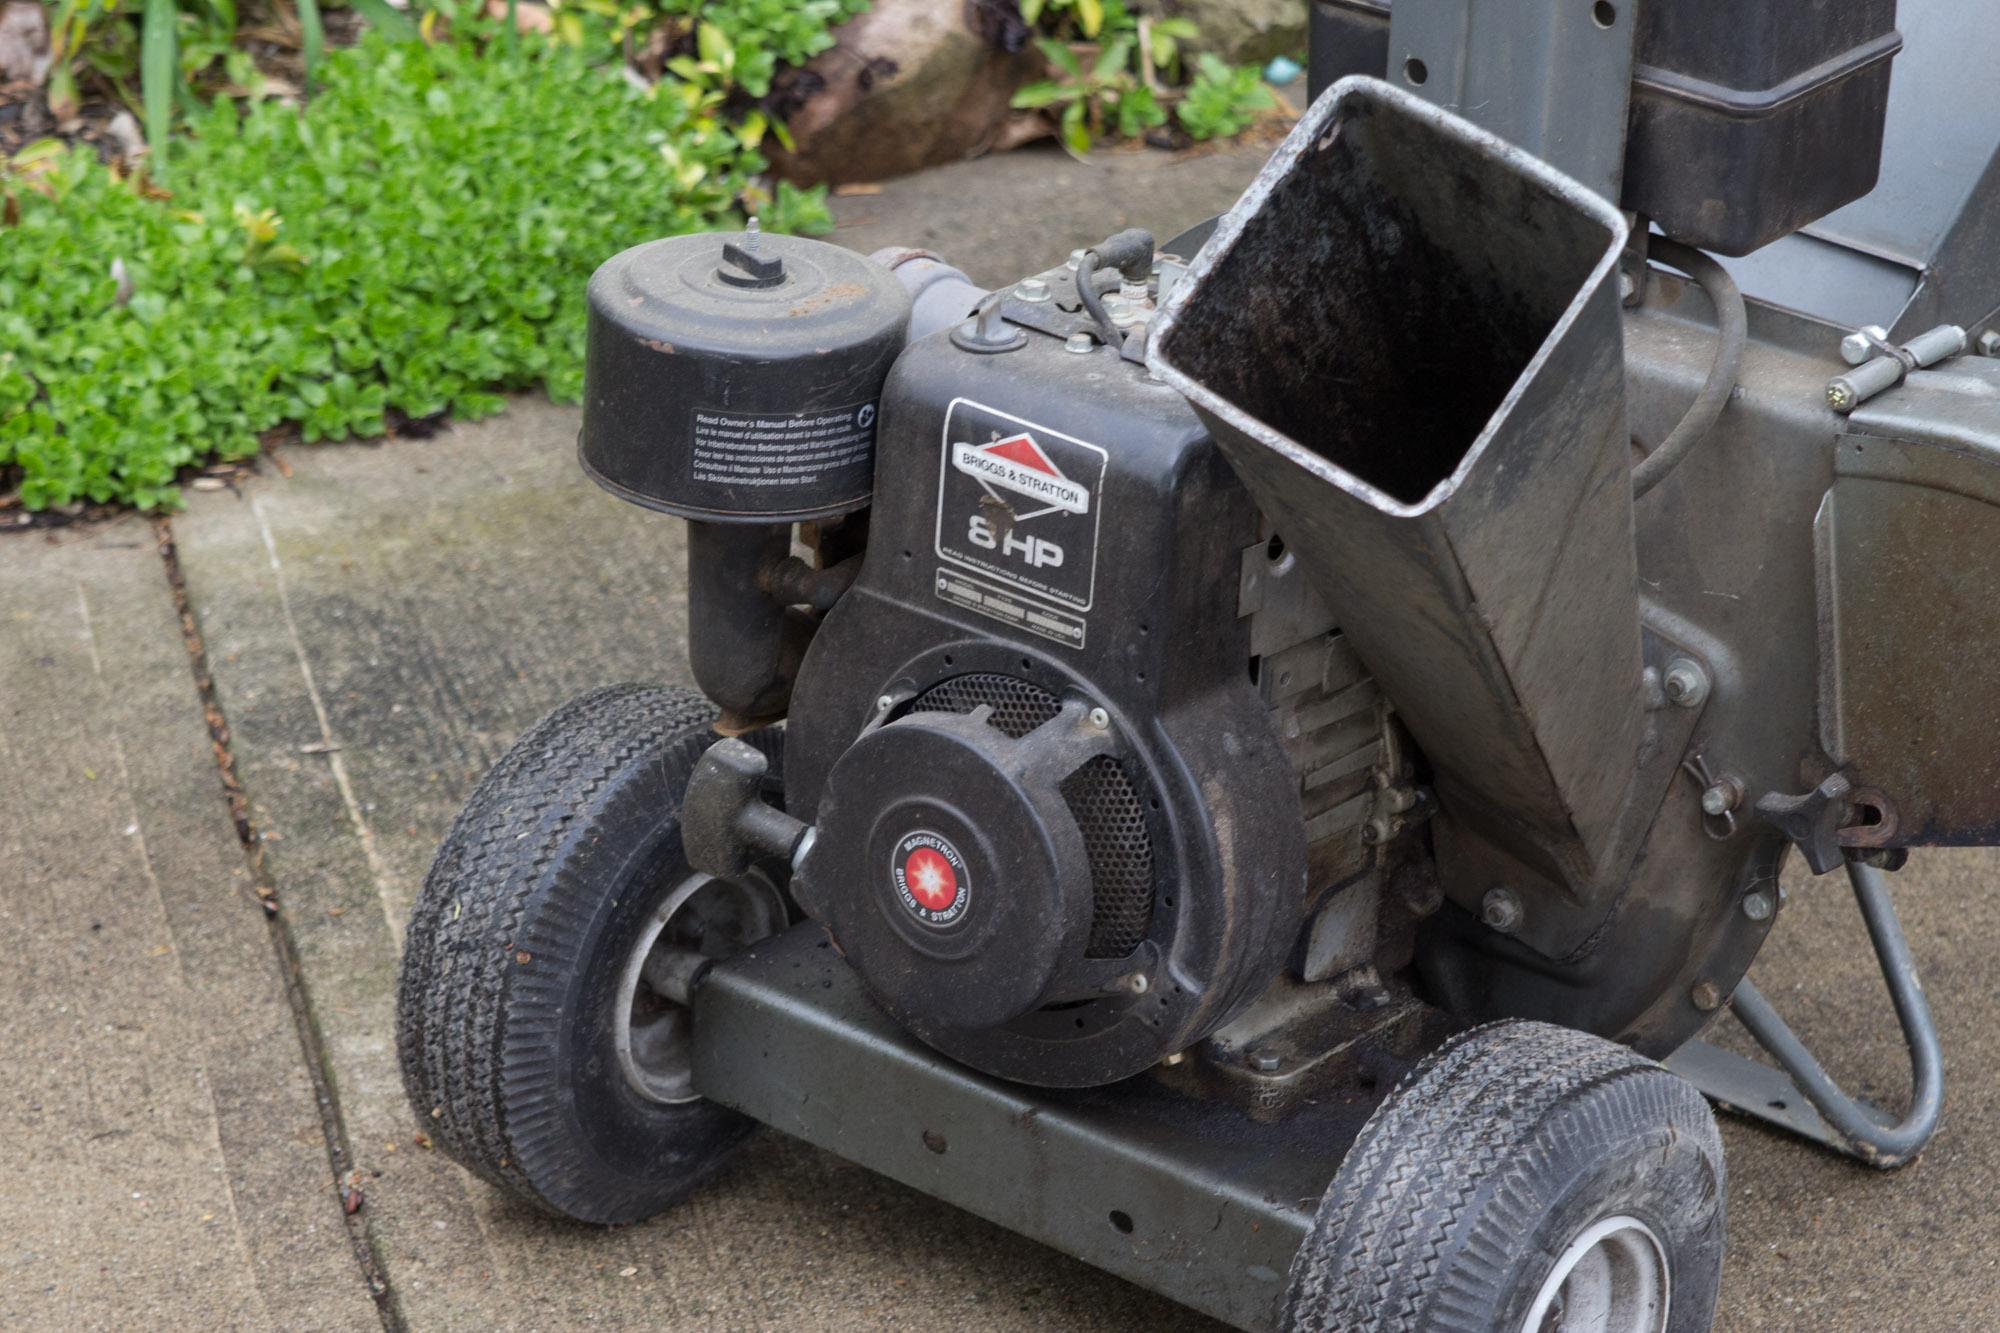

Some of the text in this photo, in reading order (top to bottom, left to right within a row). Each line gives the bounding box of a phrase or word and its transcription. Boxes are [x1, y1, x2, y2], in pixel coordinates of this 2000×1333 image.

[697, 413, 719, 425] Read
[720, 417, 755, 428] Owner's
[756, 420, 787, 428] Manual
[788, 419, 815, 428] Before
[696, 426, 709, 435] Lire
[710, 428, 717, 437] le
[718, 430, 744, 439] manuel
[785, 431, 803, 440] avant
[804, 430, 811, 438] la
[812, 429, 827, 437] mise
[828, 428, 836, 436] en
[695, 437, 707, 447] Vor
[694, 448, 712, 459] Favor
[711, 451, 725, 460] leer
[725, 453, 734, 461] las
[734, 454, 776, 463] instrucciones
[776, 455, 785, 463] de
[694, 460, 728, 472] Consultare
[733, 464, 761, 474] Manuale
[763, 466, 777, 474] Uso
[962, 452, 1080, 504] BRIGGS & STRATTON
[1002, 528, 1064, 568] HP
[942, 546, 1086, 606] READ INSTRUCTIONS BEFORE STARTING
[896, 867, 966, 921] BRIGGS & STRATTON
